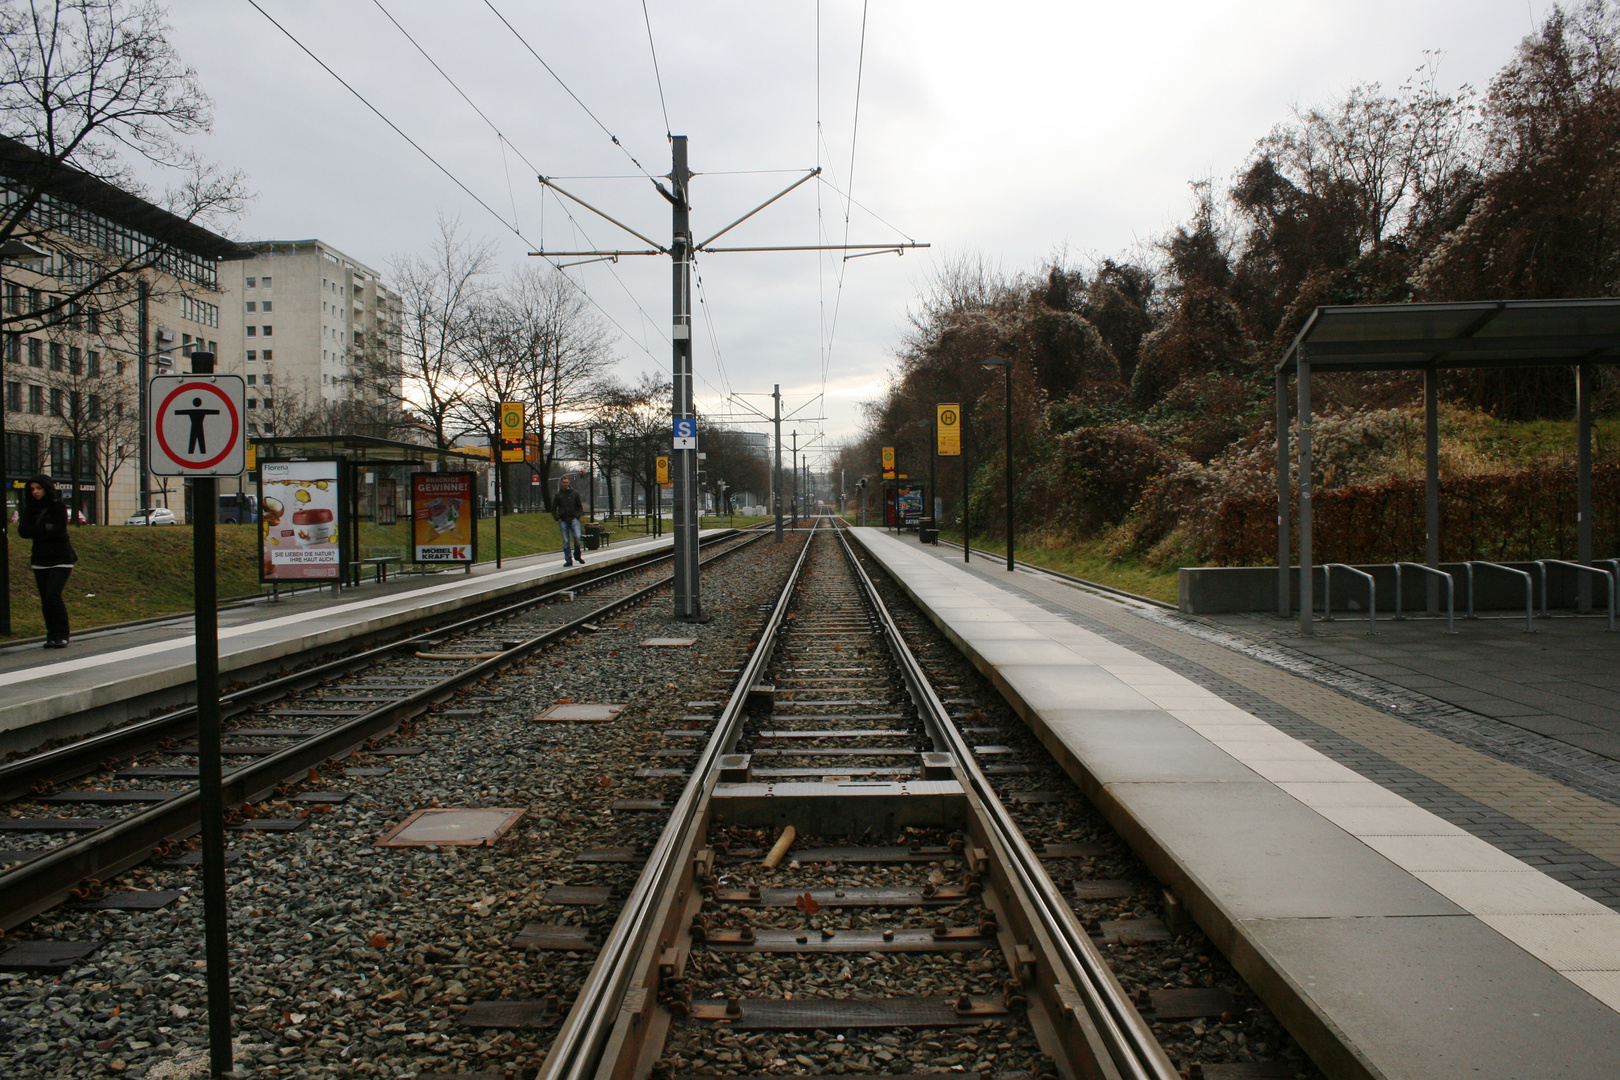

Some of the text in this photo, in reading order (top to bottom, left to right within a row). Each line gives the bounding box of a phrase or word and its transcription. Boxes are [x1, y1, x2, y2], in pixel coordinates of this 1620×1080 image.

[508, 415, 516, 425] H
[945, 413, 952, 423] H
[678, 421, 691, 438] S
[417, 483, 468, 492] GEWINNE!
[421, 546, 466, 559] MÖBEL K
